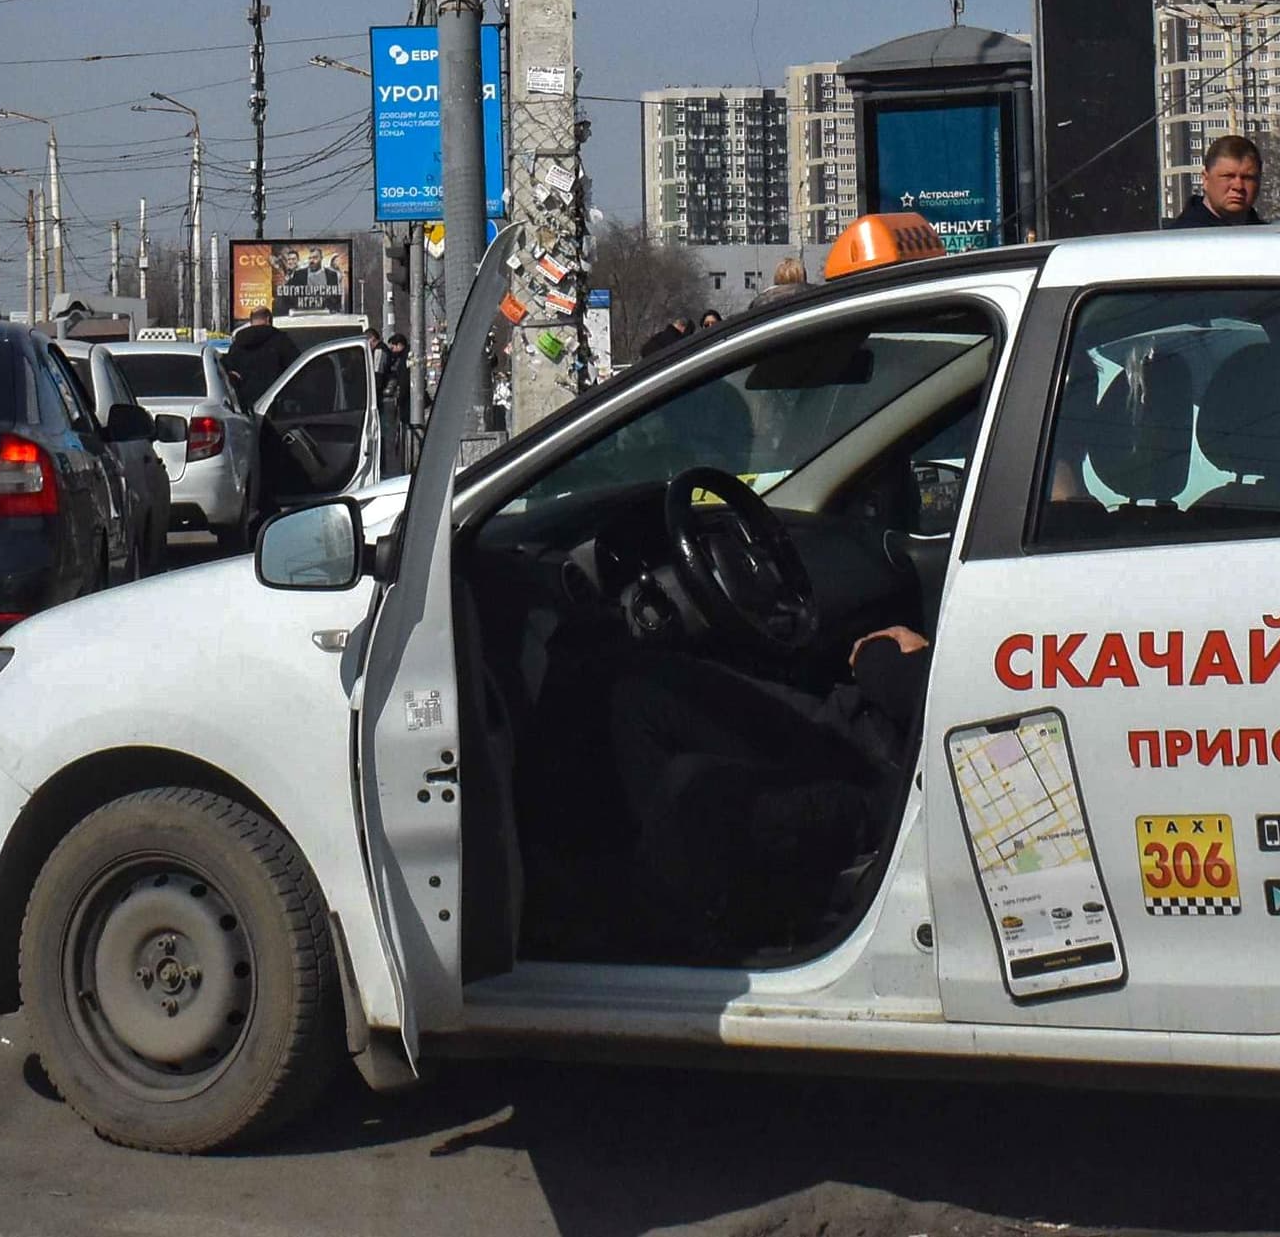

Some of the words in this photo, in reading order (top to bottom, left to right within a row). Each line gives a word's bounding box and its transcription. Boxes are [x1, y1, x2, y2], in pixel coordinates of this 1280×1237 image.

[378, 84, 496, 102] УРОЛЯ
[392, 120, 440, 128] СЧАСТЛИВОГ
[919, 190, 970, 200] Астродент
[239, 254, 267, 267] СТС
[239, 298, 267, 308] 17:00
[297, 296, 324, 307] ИГРЫ
[1144, 819, 1223, 834] TAXI
[1144, 842, 1232, 889] 306
